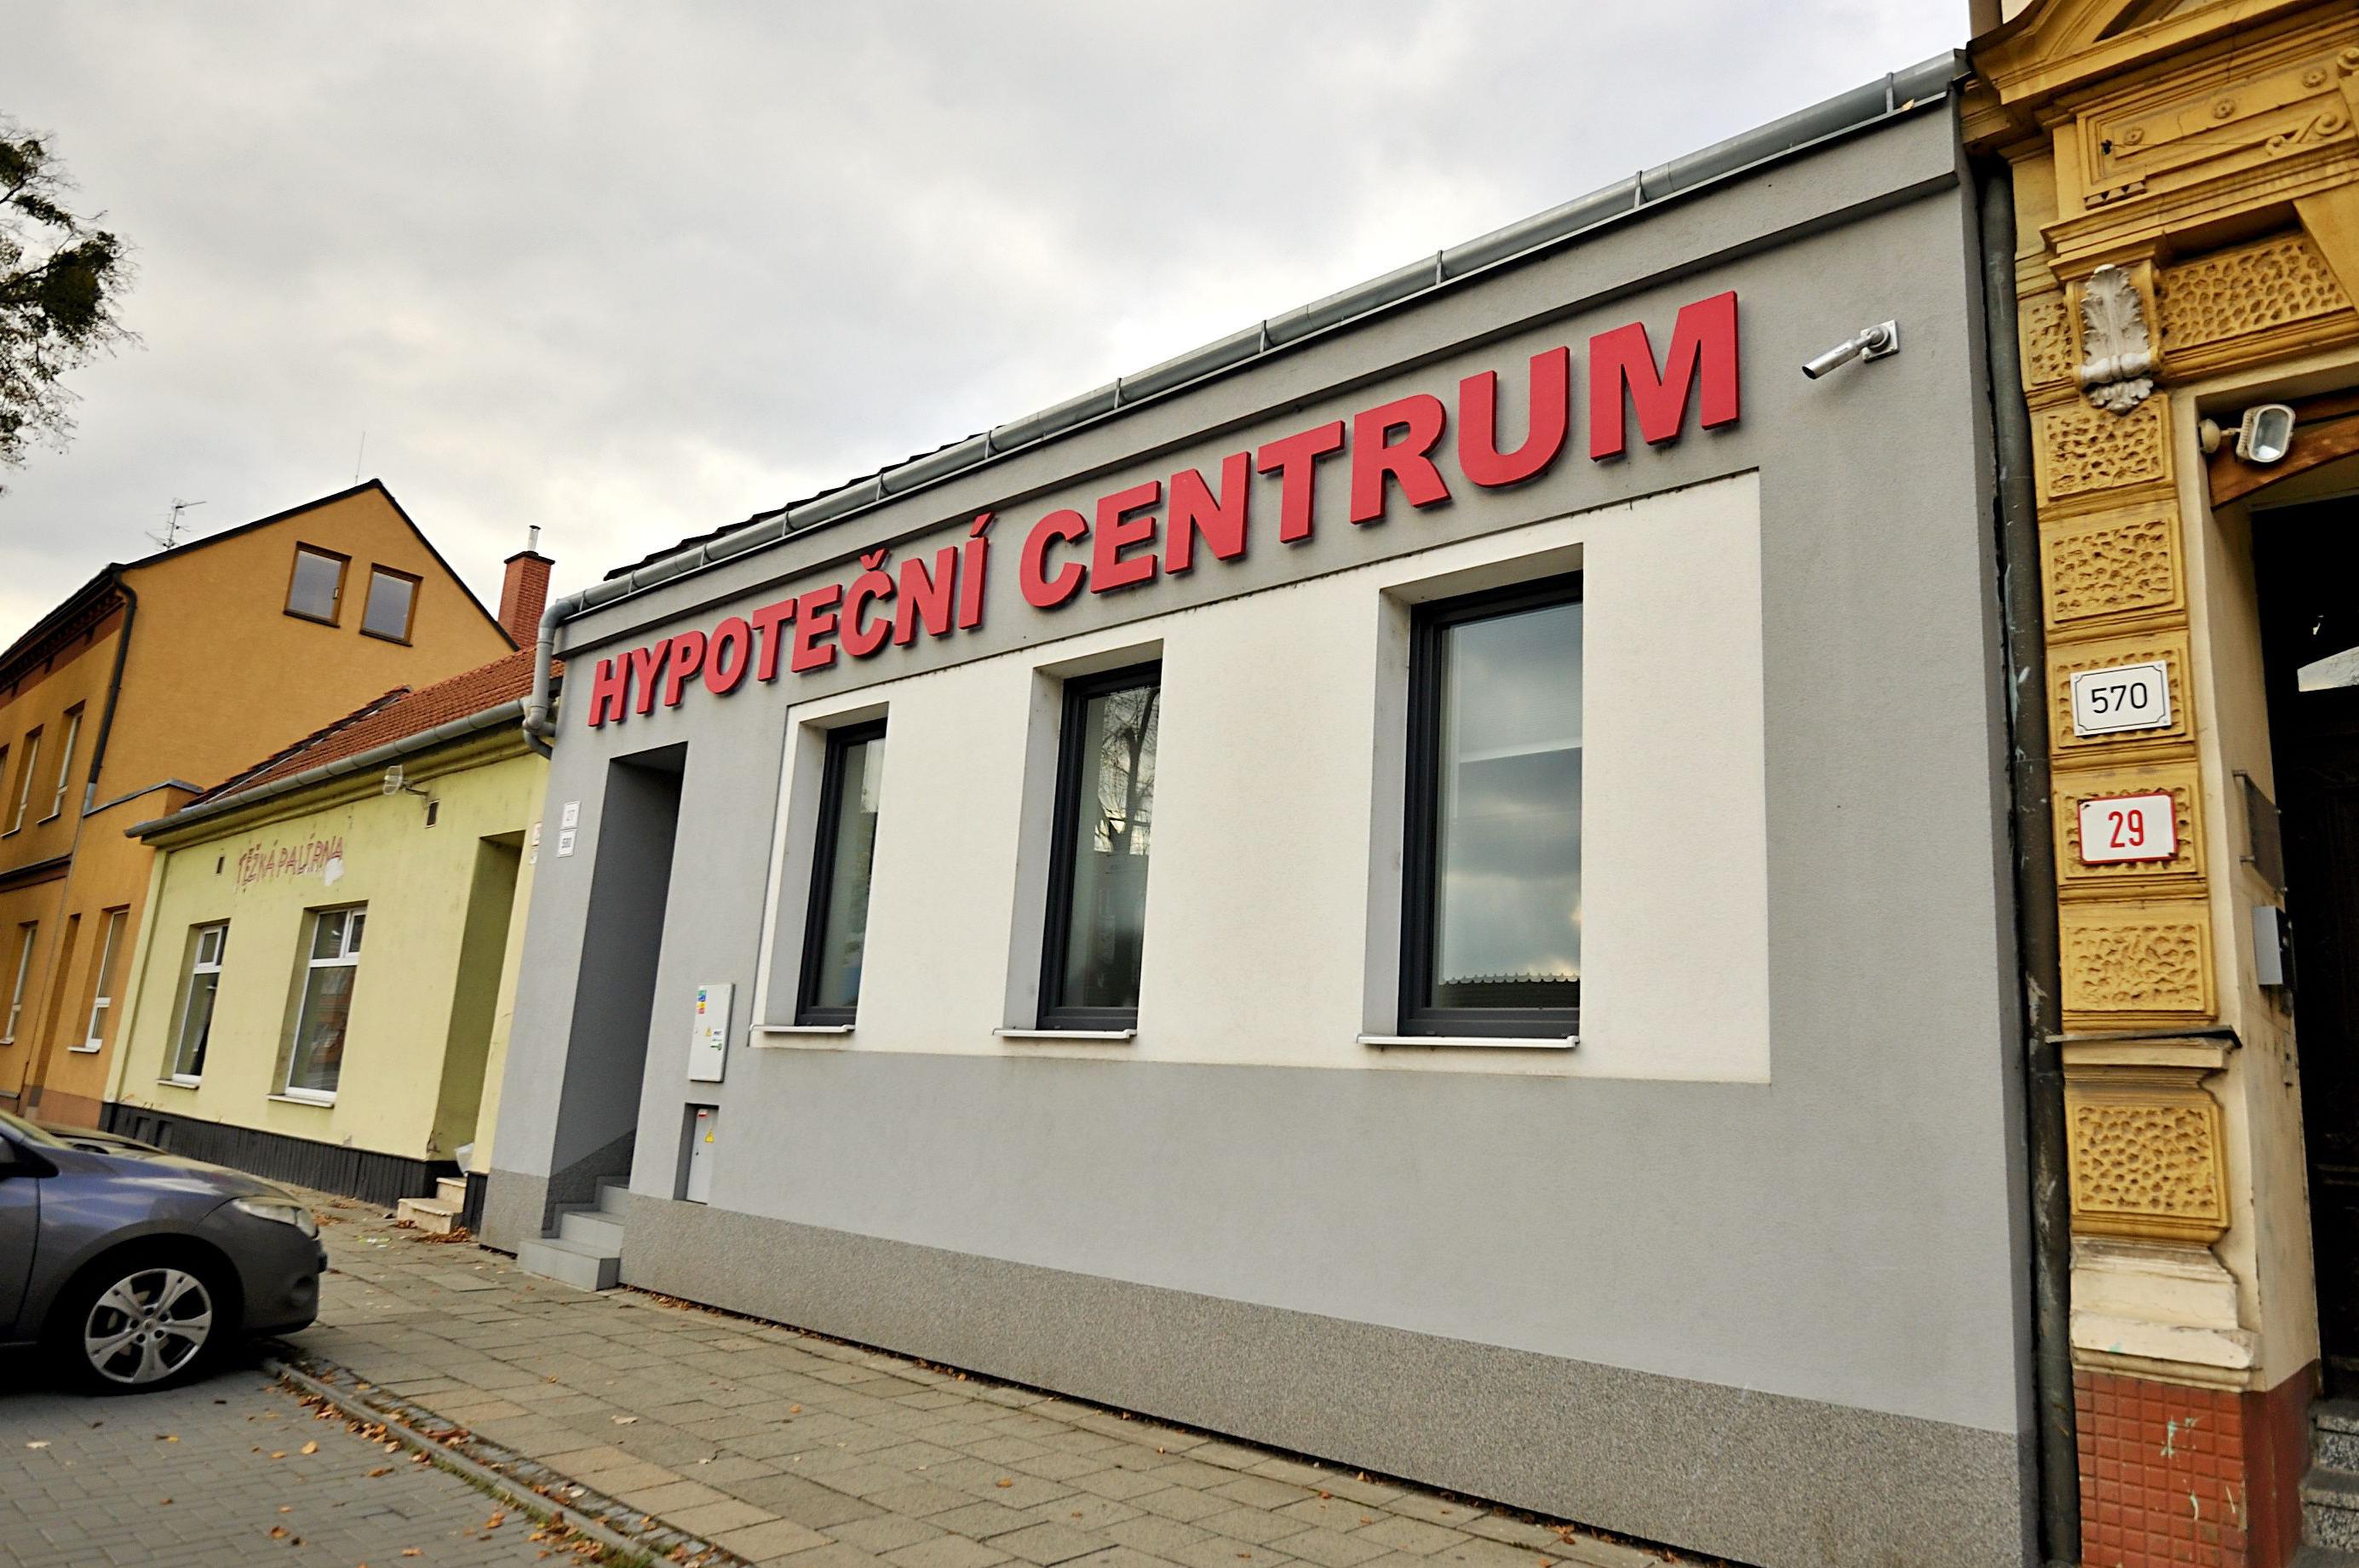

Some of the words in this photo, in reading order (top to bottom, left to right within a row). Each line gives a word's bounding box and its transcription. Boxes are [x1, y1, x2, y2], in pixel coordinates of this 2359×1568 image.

[587, 512, 995, 727] HYPOTEČNÍ
[1019, 290, 1740, 609] CENTRUM
[2091, 682, 2148, 714] 570
[2108, 809, 2144, 848] 29
